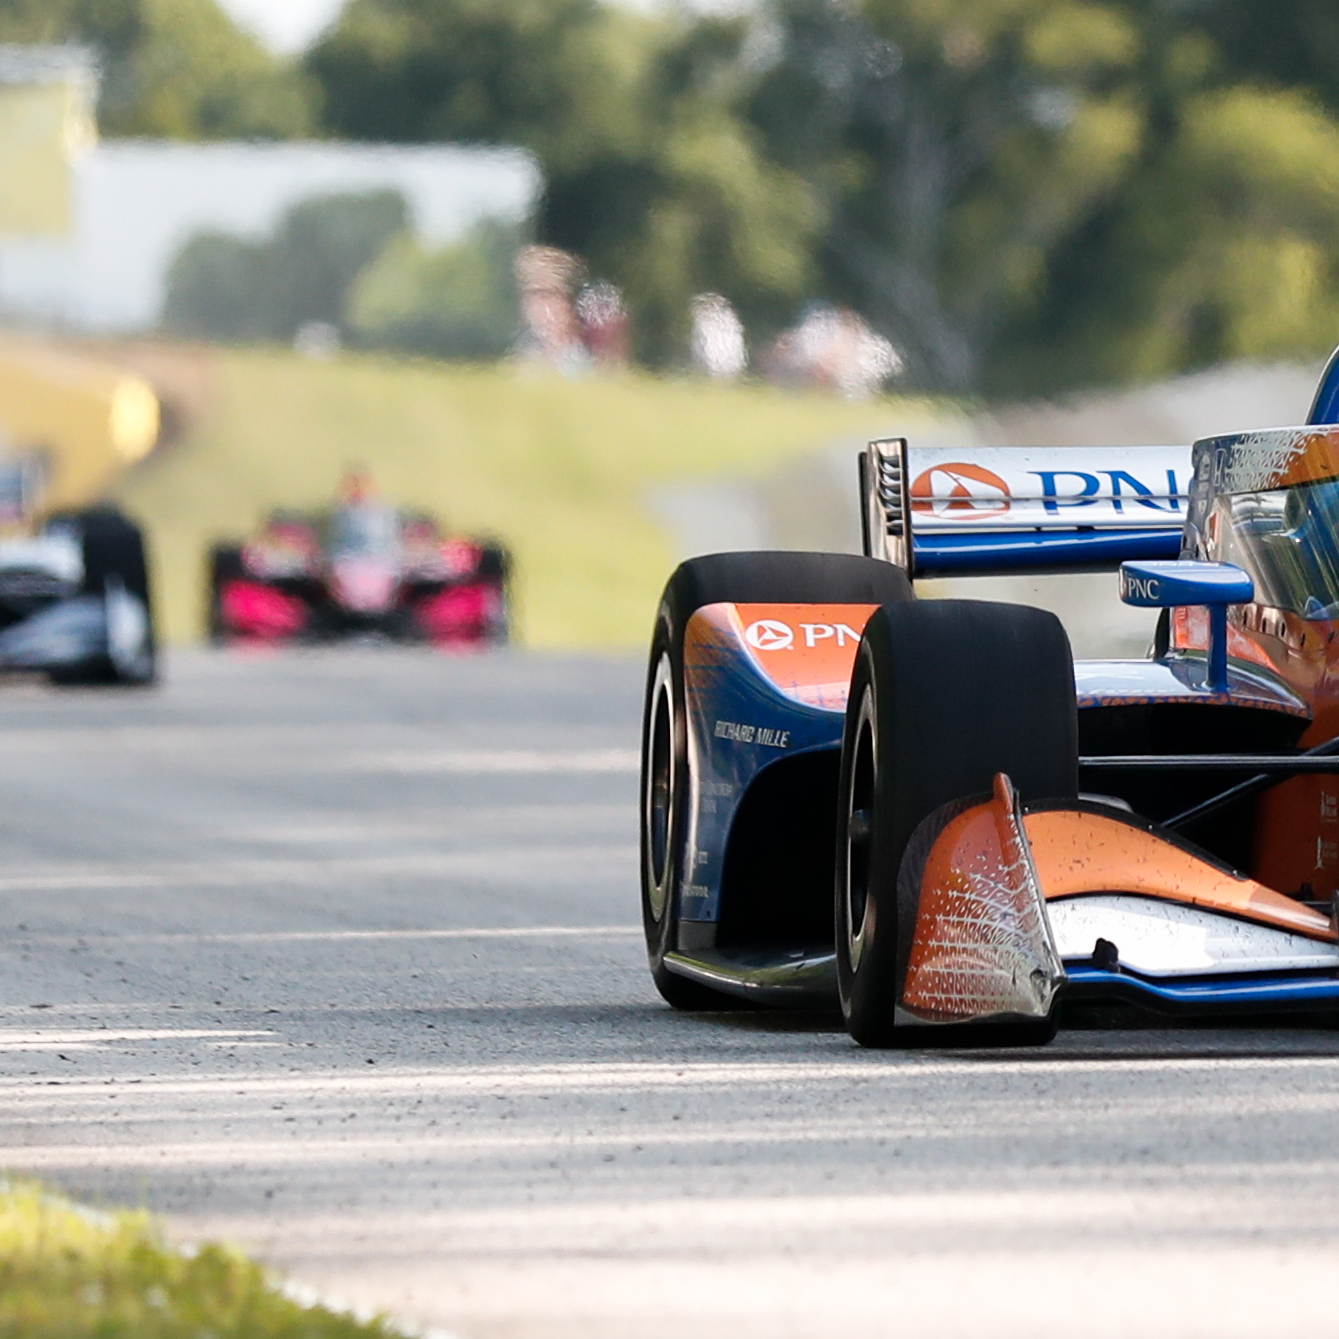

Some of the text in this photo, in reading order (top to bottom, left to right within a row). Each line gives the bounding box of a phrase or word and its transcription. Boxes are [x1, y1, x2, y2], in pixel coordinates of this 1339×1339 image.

[1026, 469, 1182, 515] PN
[1128, 578, 1160, 601] PNC
[799, 623, 865, 647] PN
[755, 727, 791, 748] MILLE
